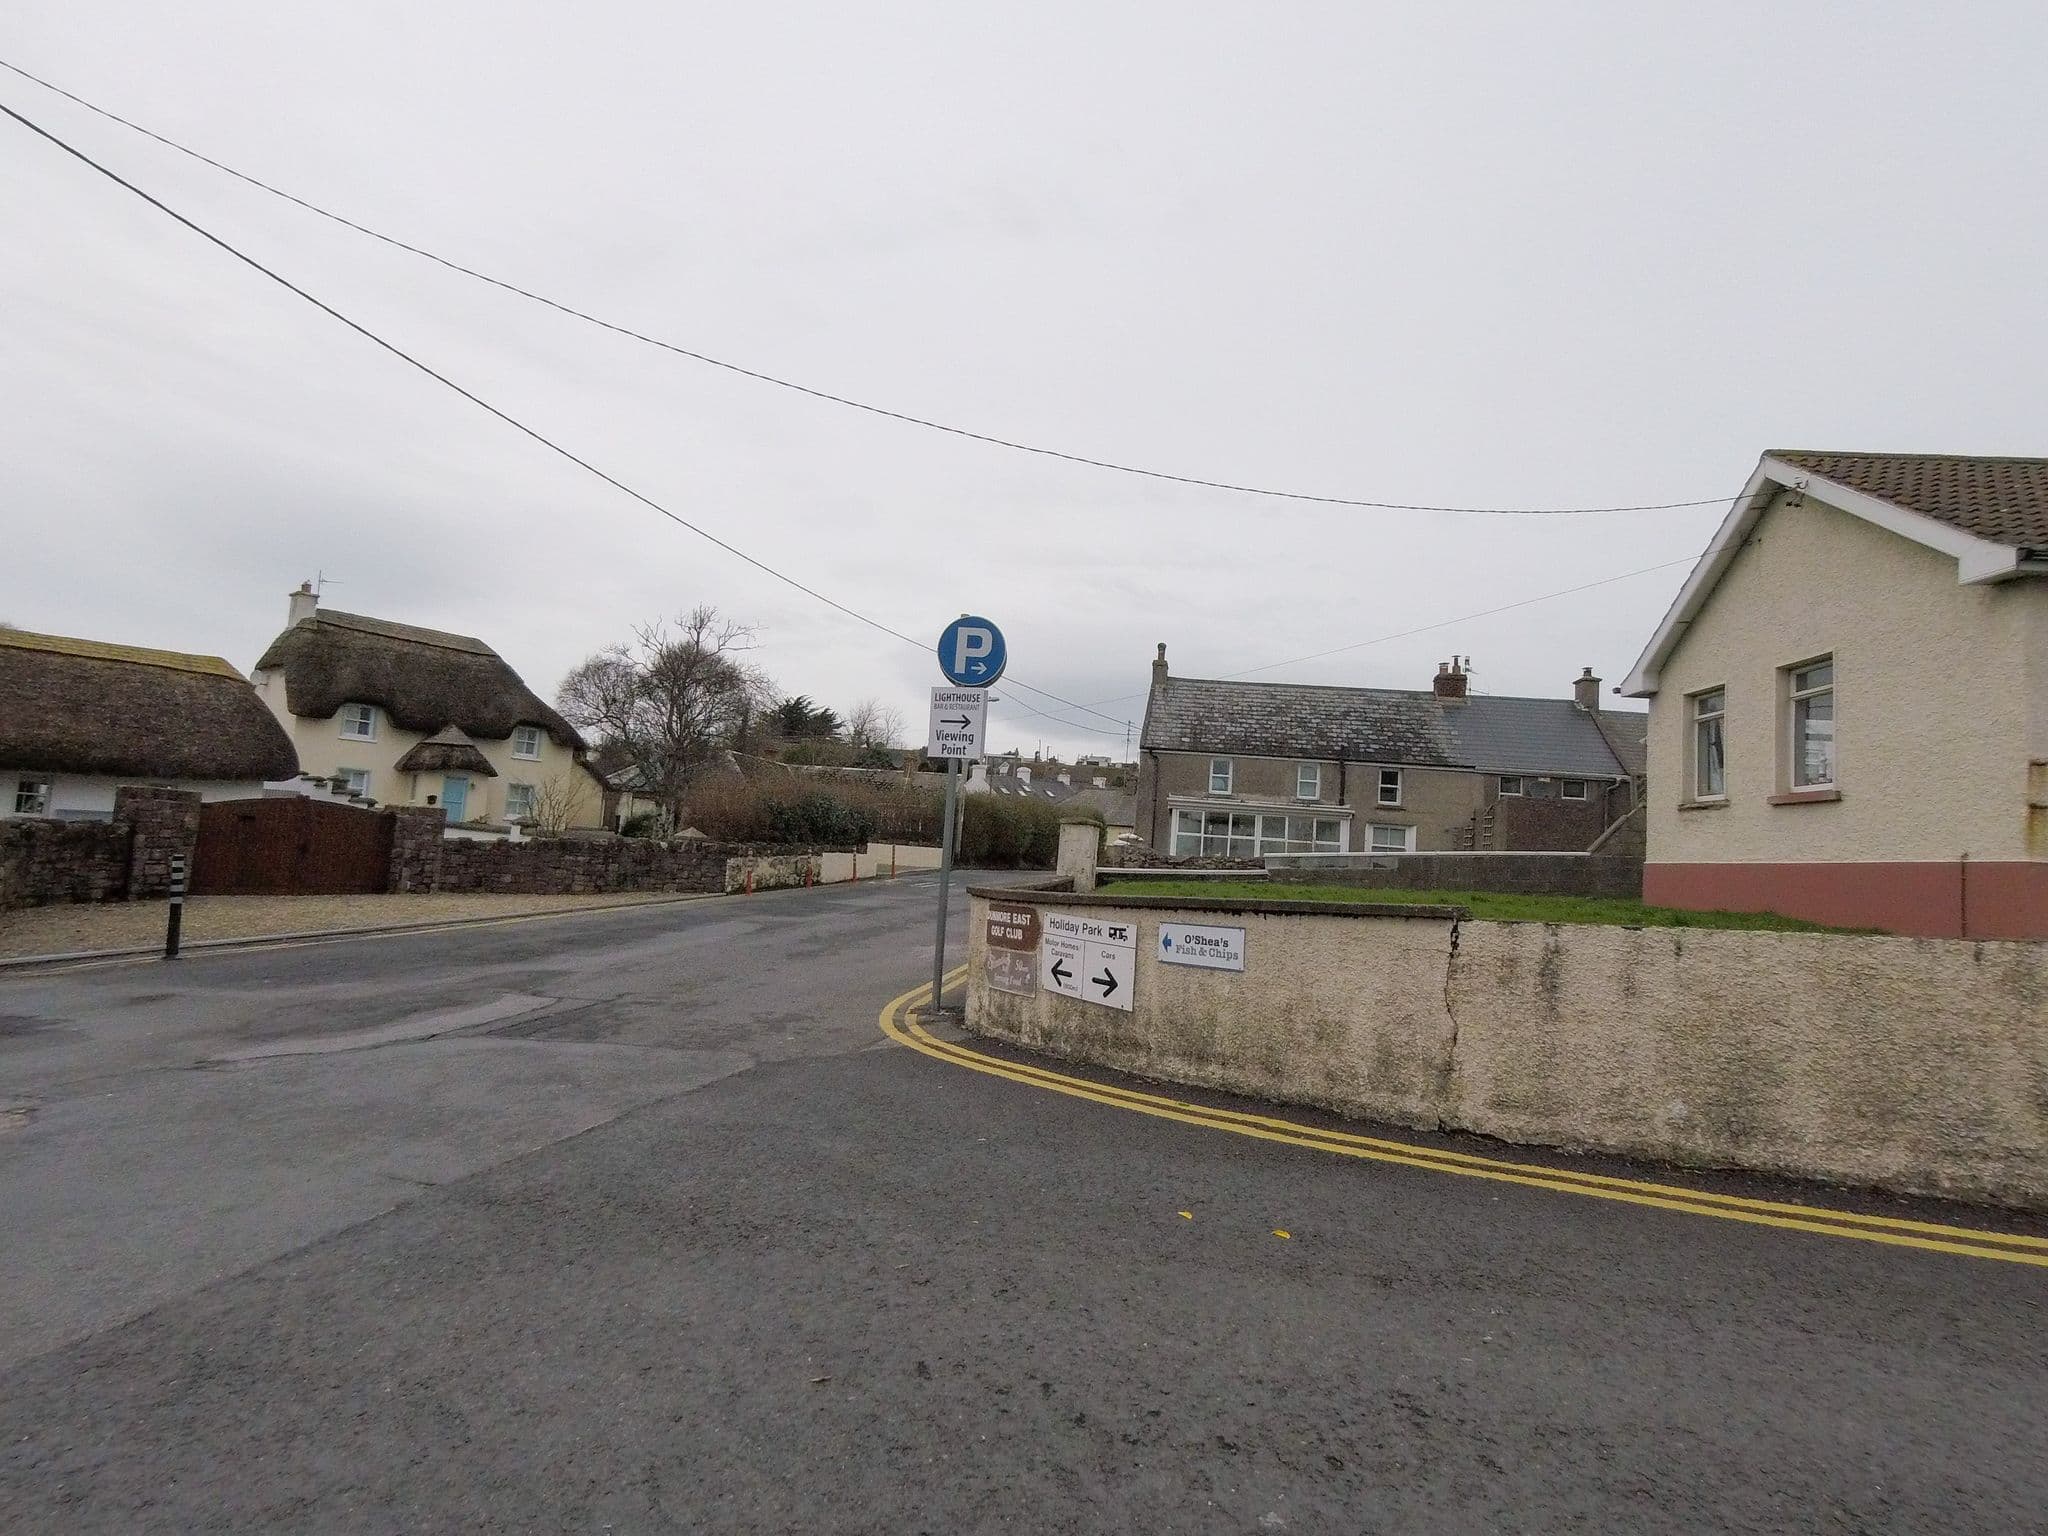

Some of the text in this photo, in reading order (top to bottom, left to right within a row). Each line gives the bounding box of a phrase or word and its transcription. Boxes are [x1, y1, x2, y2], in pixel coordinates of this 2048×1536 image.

[954, 627, 993, 674] P
[934, 693, 981, 703] LIGHTHOUSE
[936, 729, 974, 745] Viewing
[941, 743, 967, 756] Point
[1012, 912, 1031, 926] EAST
[991, 925, 1023, 940] GOLF CLUB
[1049, 917, 1102, 937] Holiday Park
[1045, 938, 1059, 947] Motor
[1184, 934, 1229, 948] O'Shea's
[1051, 948, 1074, 960] Caravans
[1101, 950, 1116, 960] Cars
[1175, 944, 1239, 961] Fish & Chips
